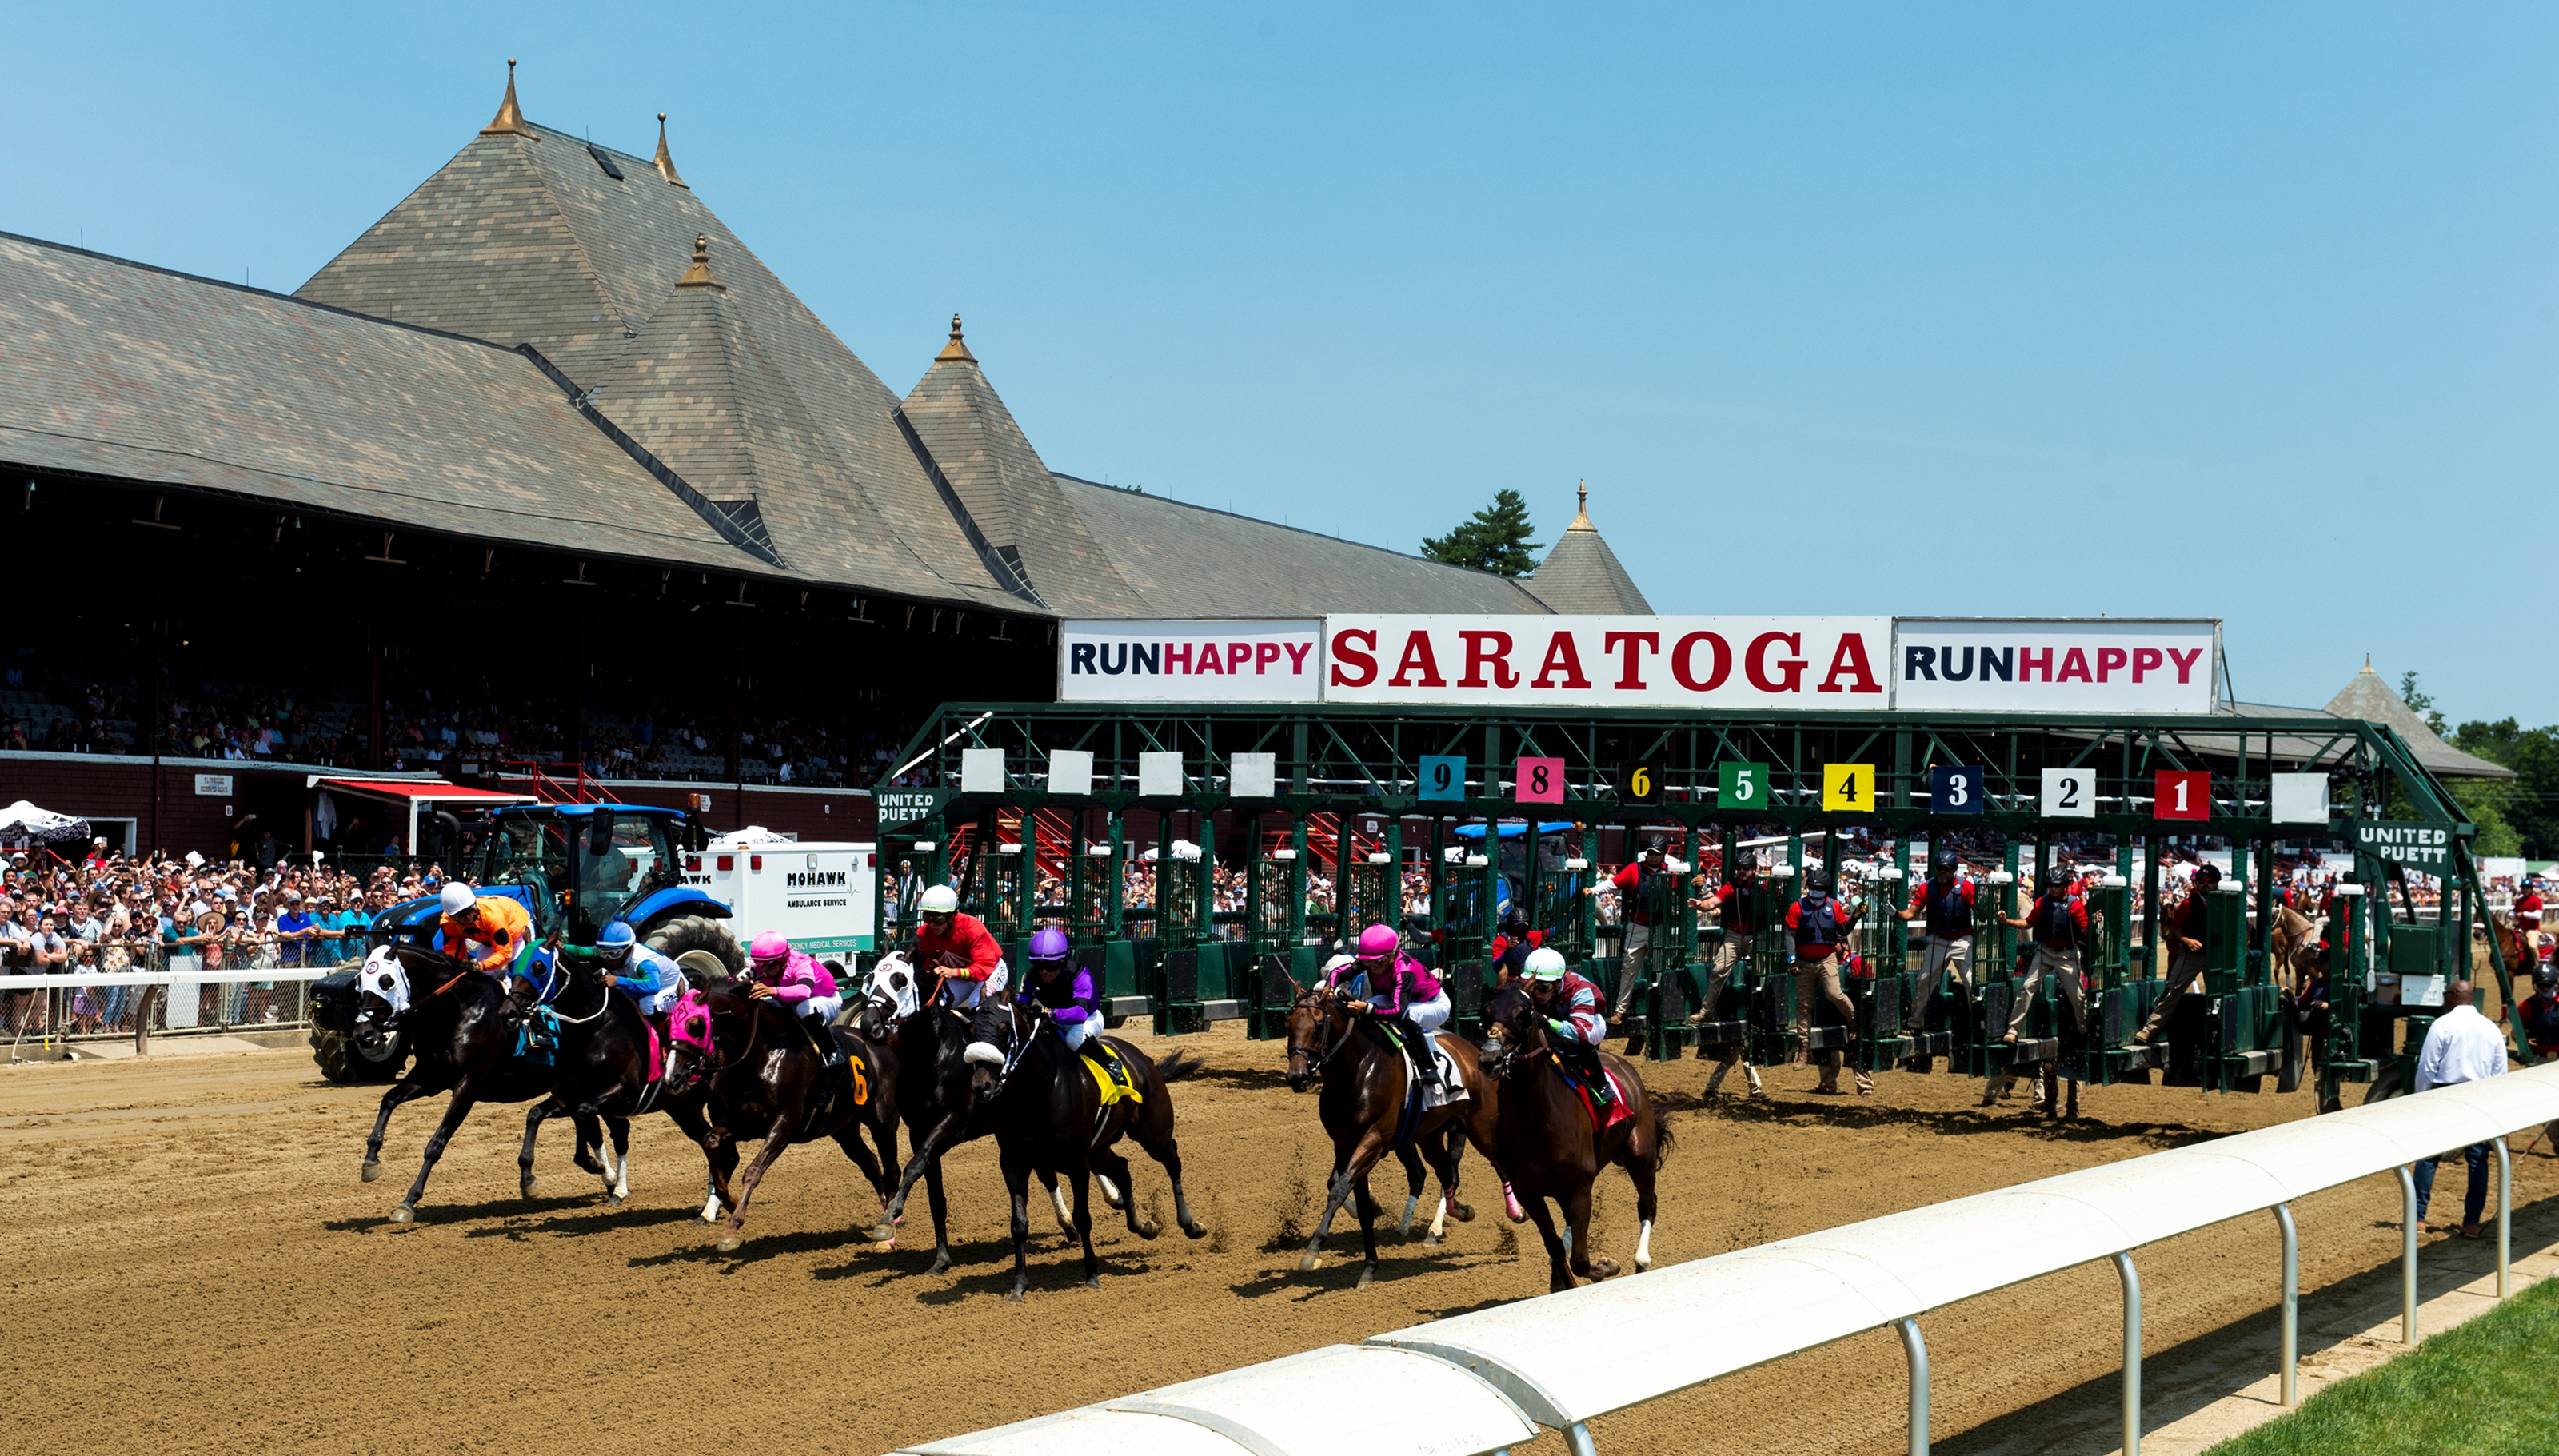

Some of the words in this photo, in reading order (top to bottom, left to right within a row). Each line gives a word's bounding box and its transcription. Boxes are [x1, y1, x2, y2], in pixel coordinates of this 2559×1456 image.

[1071, 642, 1314, 675] RUNHAPPY
[1331, 628, 1882, 693] SARATOGA
[1905, 645, 2204, 684] RUNHAPPY
[1434, 763, 1451, 792] 9
[1531, 765, 1549, 794] 8
[1631, 767, 1651, 797] 6
[1735, 770, 1754, 800] 5
[1838, 772, 1858, 802] 4
[1949, 774, 1968, 806] 3
[879, 794, 934, 807] UNITED
[2058, 778, 2079, 808] 2
[2174, 779, 2189, 812] 1
[878, 808, 929, 823] PUETT
[2361, 828, 2446, 845] UNITED
[2381, 845, 2447, 864] PUETT
[787, 872, 846, 888] MOHAWK
[809, 940, 831, 949] MEDICAL
[850, 1055, 868, 1105] 6
[1433, 1050, 1465, 1095] 2
